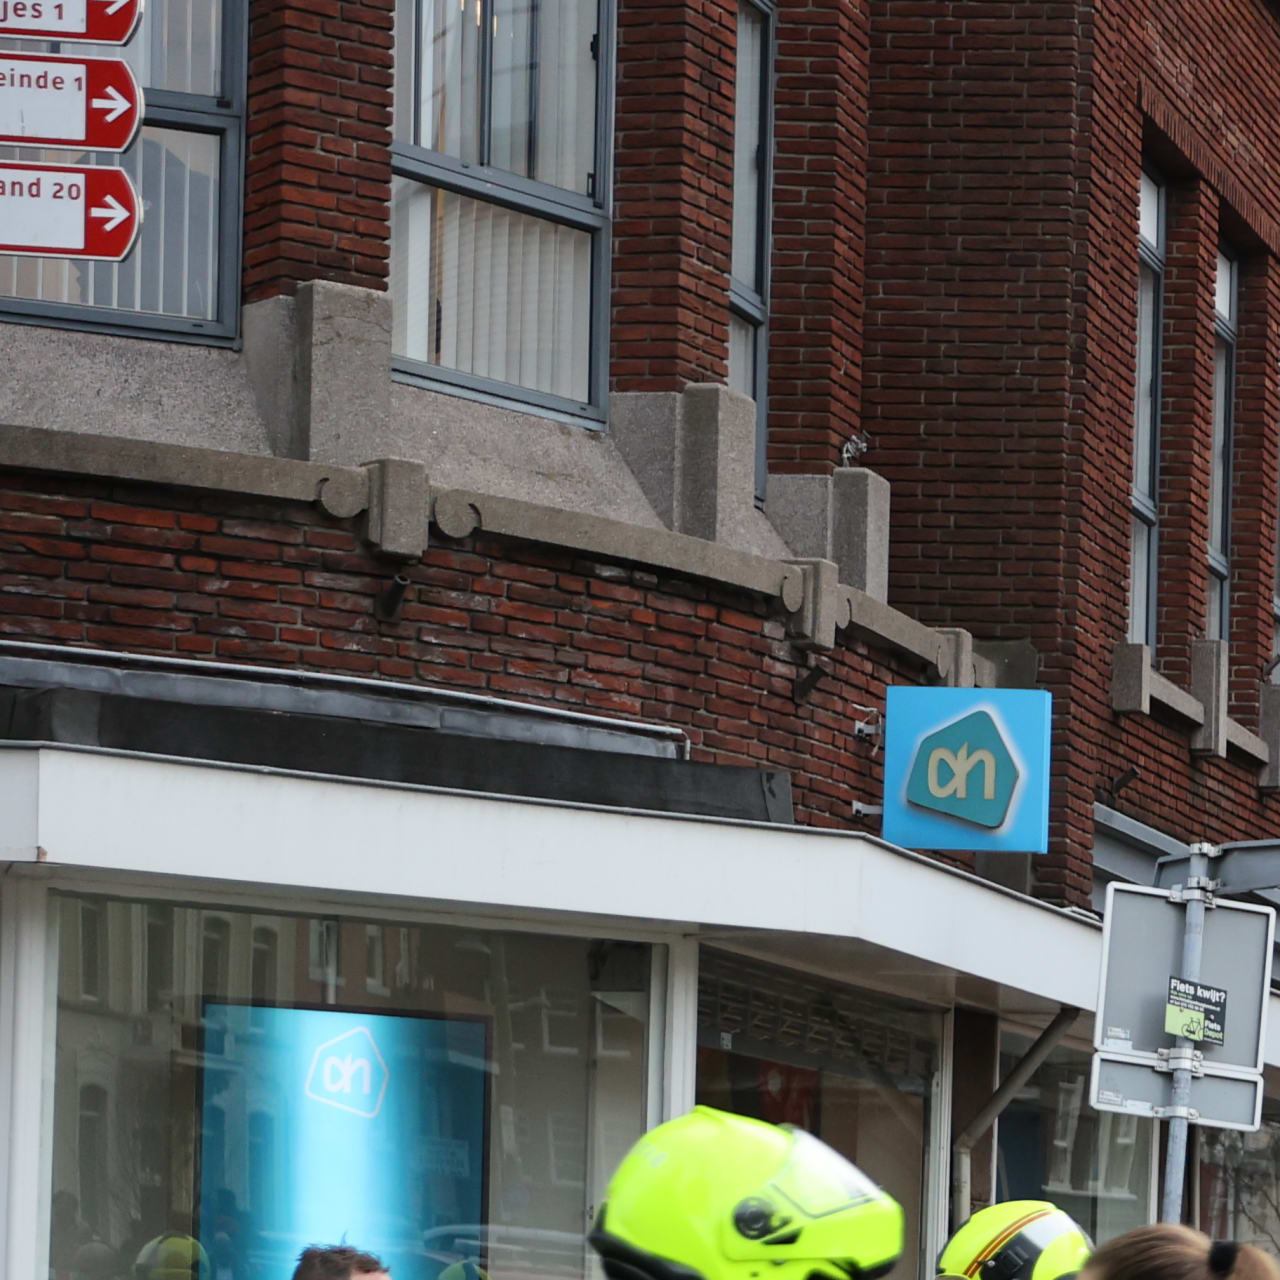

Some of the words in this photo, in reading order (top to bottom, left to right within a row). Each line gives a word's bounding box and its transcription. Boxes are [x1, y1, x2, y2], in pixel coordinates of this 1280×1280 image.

[54, 3, 64, 20] 1
[74, 76, 83, 91] 1
[52, 182, 81, 200] 20
[1170, 978, 1195, 995] Fiets
[1196, 985, 1226, 1003] kwijt?
